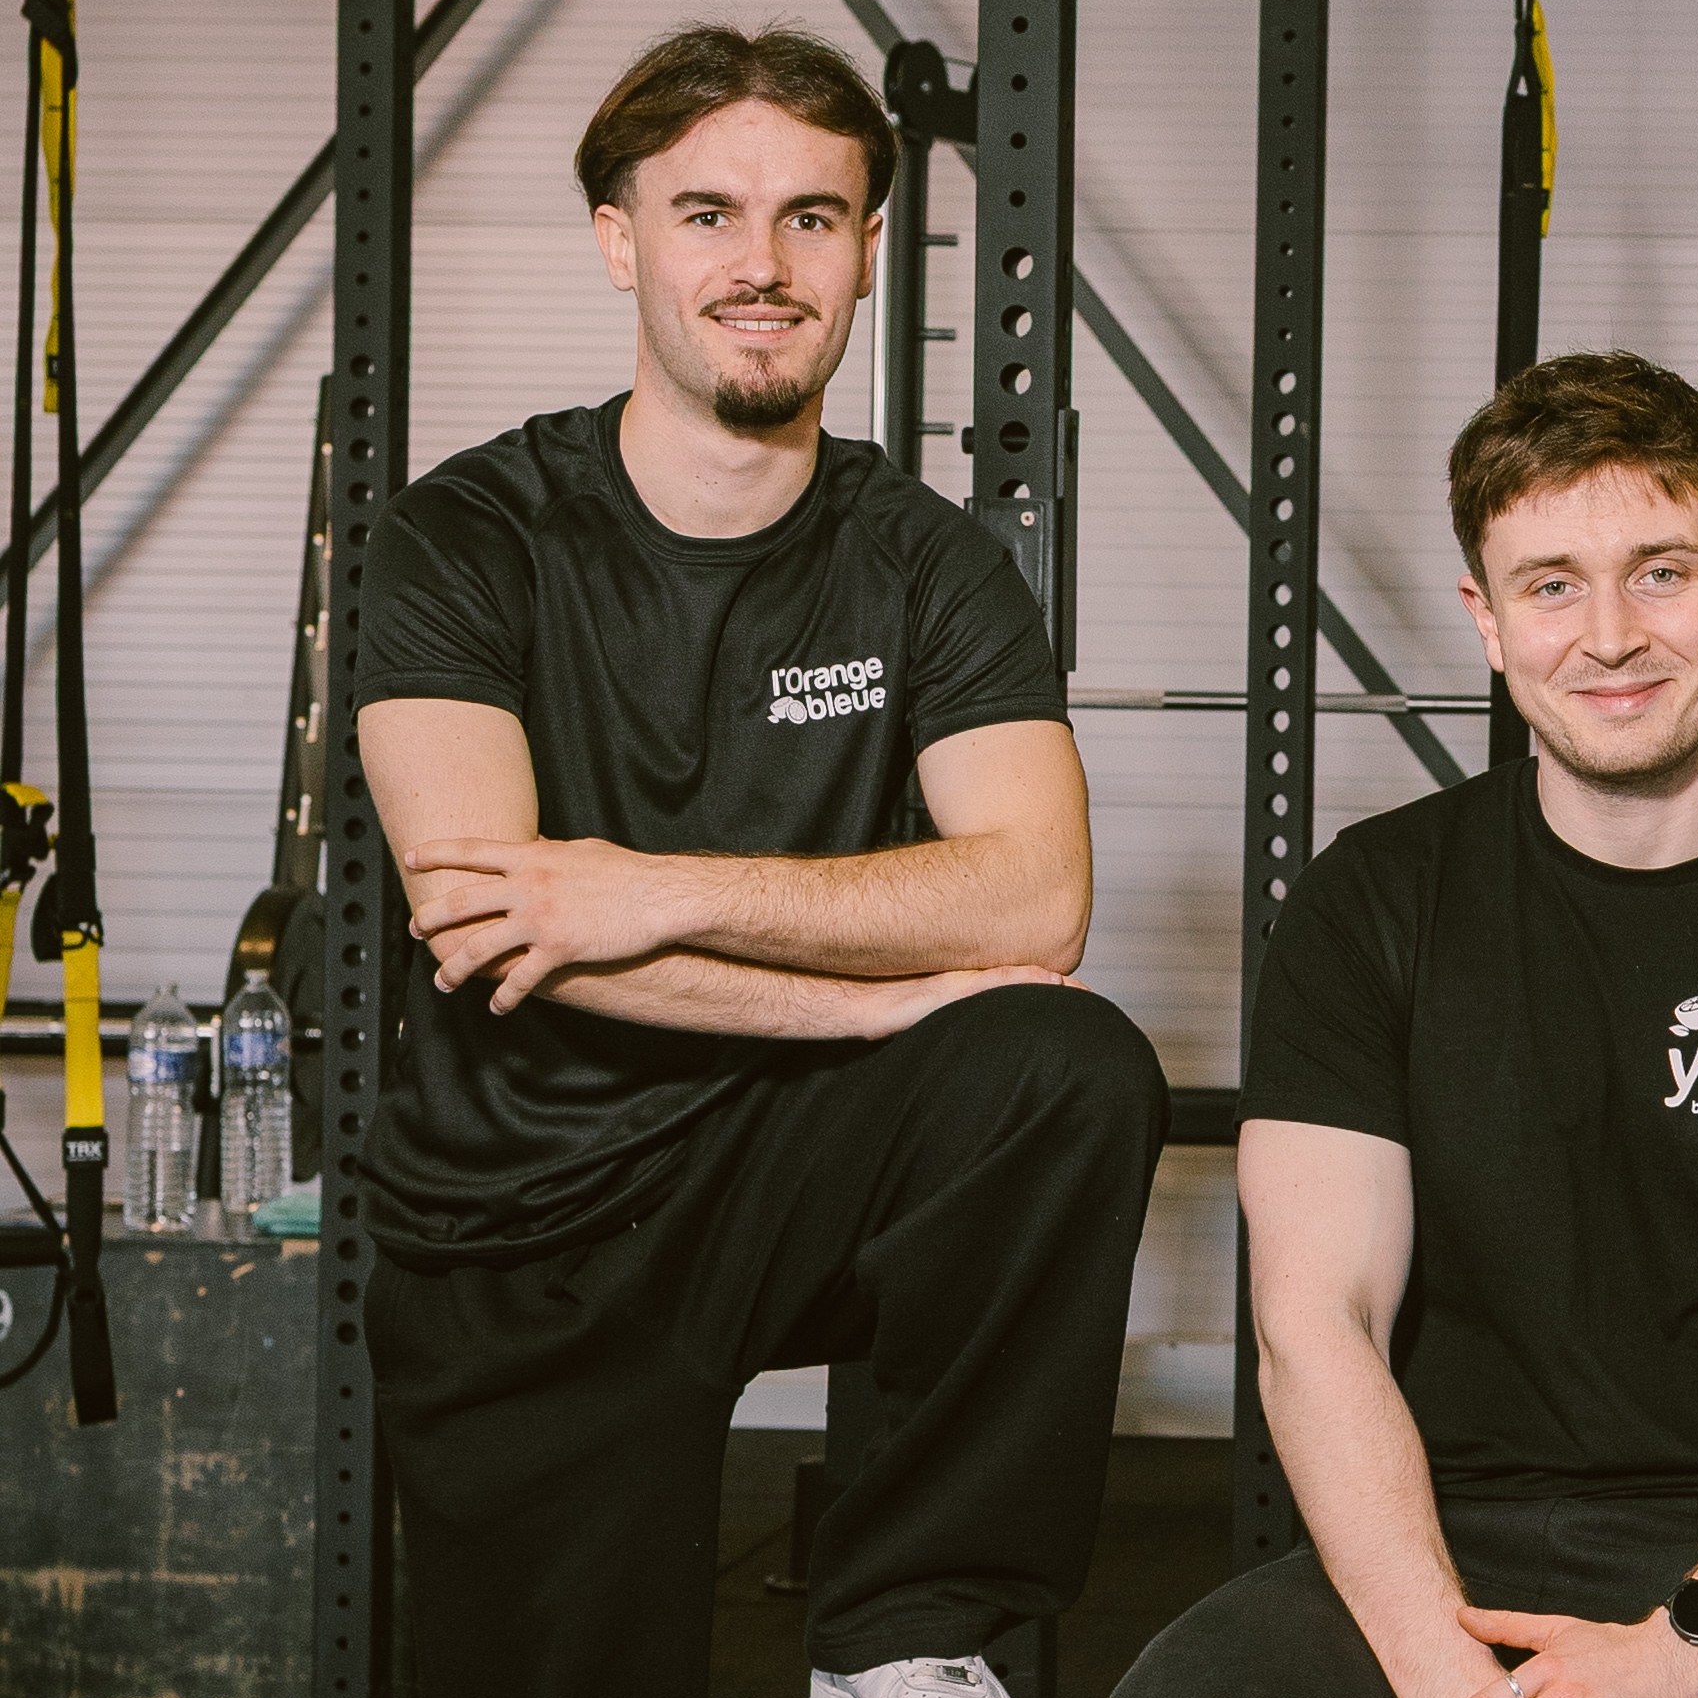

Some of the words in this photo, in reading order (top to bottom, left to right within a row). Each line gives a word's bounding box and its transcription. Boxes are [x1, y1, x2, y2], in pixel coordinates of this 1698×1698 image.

[772, 657, 883, 696] l'Orange
[805, 687, 885, 720] bleue
[66, 1141, 103, 1158] TRX
